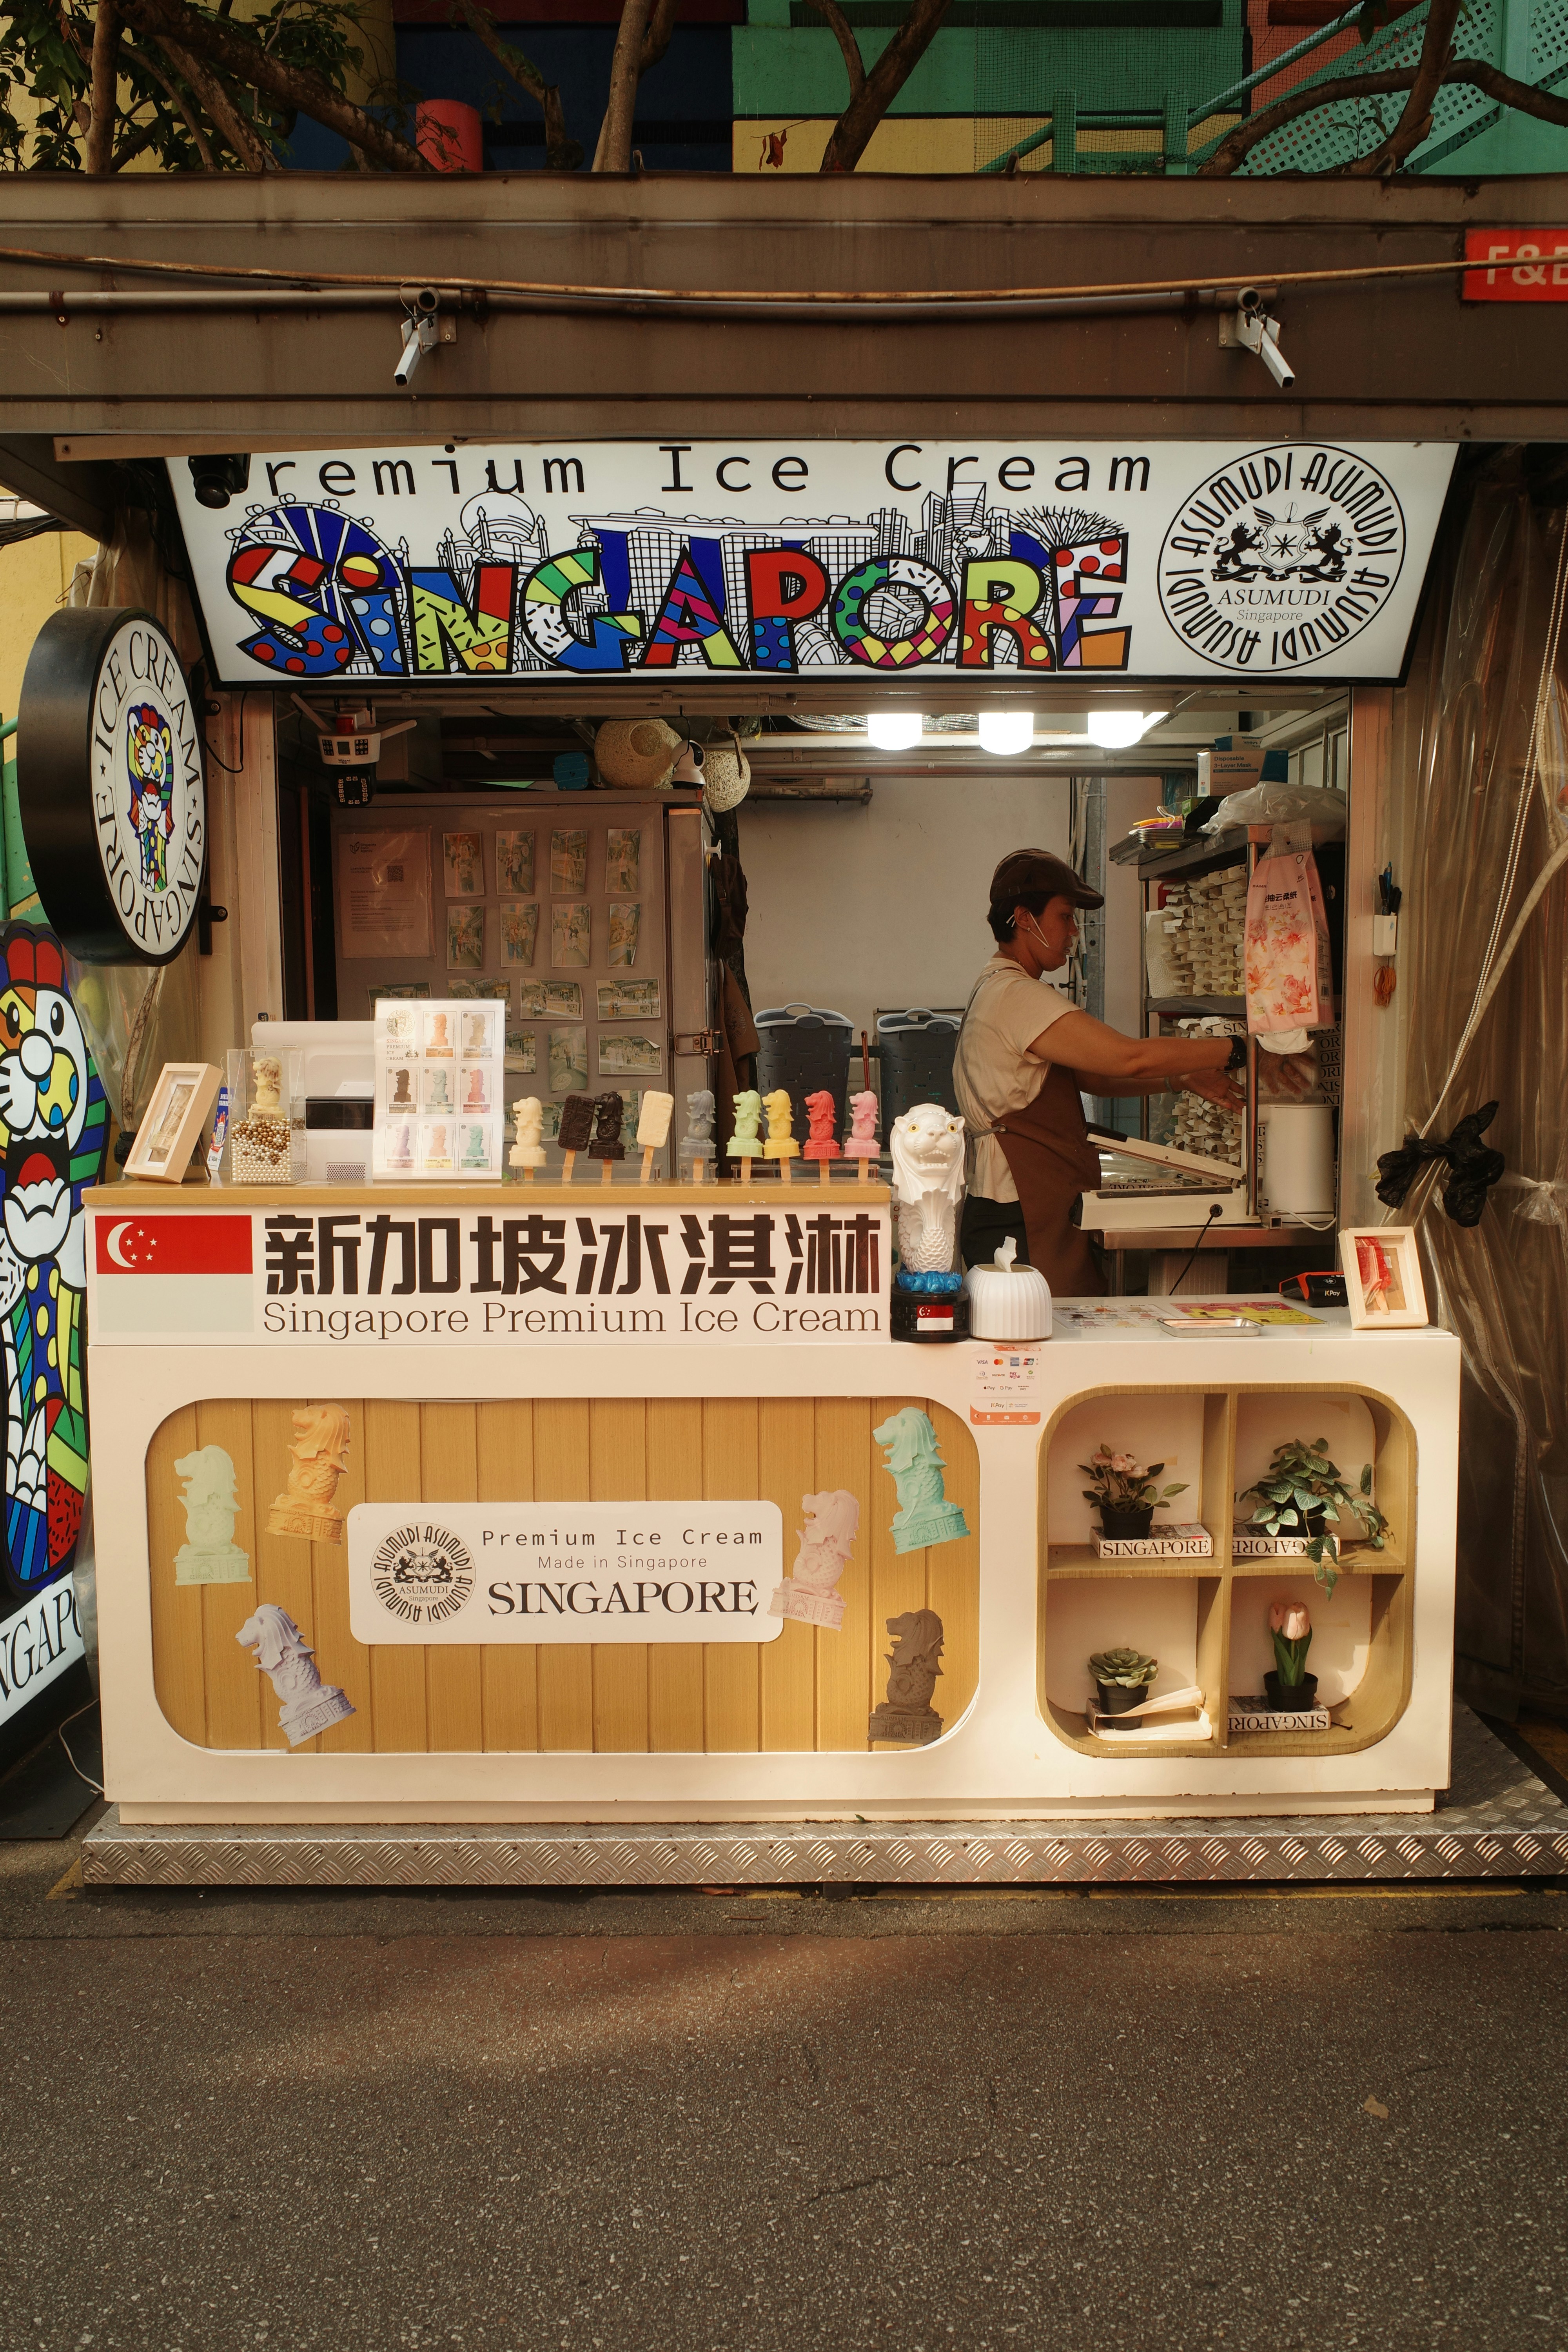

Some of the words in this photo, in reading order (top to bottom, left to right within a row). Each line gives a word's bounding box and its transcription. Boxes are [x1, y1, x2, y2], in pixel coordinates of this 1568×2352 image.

[265, 445, 584, 496] remium
[659, 445, 809, 493] Ice
[885, 444, 1151, 492] Cream
[1171, 452, 1292, 558] ASUMUDI
[1300, 452, 1398, 557] ASUMUDI
[1165, 568, 1261, 665] ASUMUDI
[1216, 589, 1332, 606] ASUMUDI
[1236, 608, 1303, 623] Singapore
[1271, 566, 1390, 665] ASUMUDI
[96, 652, 127, 754] ICE
[128, 630, 203, 785] CREAM
[95, 785, 203, 946] SINGAPORE
[265, 1214, 881, 1295] 新加坡冰淇淋
[263, 1302, 469, 1340] Singapore
[483, 1302, 664, 1333] Premium
[679, 1302, 738, 1332] Ice
[753, 1301, 882, 1332] Cream
[374, 1525, 420, 1573] ASUMUDI
[423, 1525, 473, 1571] ASUMUDI
[483, 1530, 595, 1546] Premium
[616, 1529, 662, 1545] Ice
[682, 1529, 763, 1545] Cream
[538, 1556, 584, 1568] Made
[593, 1555, 608, 1568] in
[617, 1555, 707, 1571] Singapore
[1102, 1540, 1209, 1557] SINGAPORE
[488, 1579, 760, 1616] SINGAPORE
